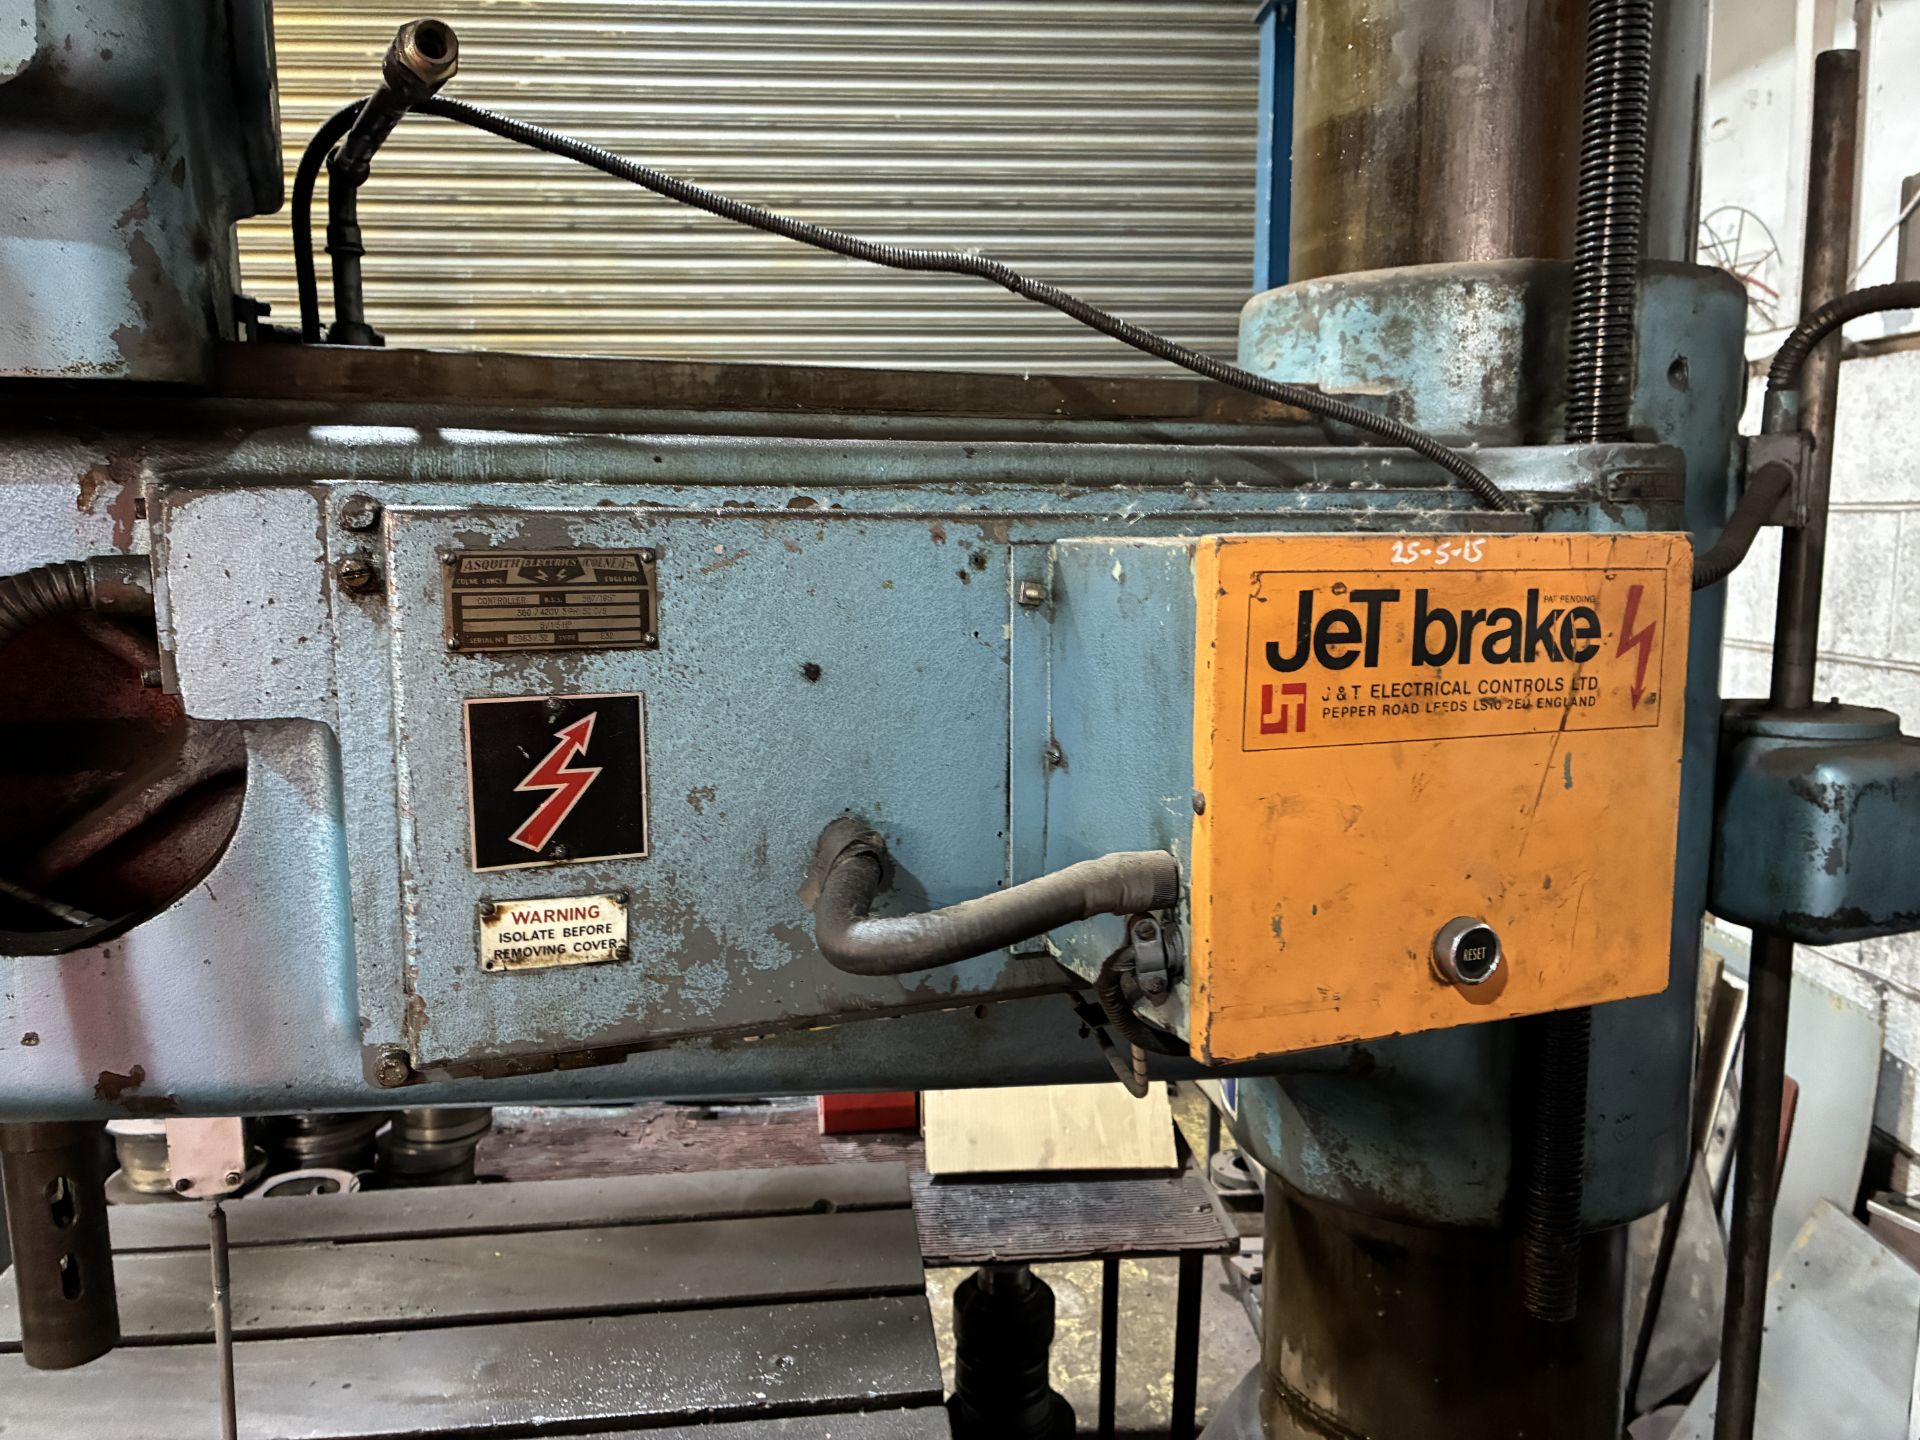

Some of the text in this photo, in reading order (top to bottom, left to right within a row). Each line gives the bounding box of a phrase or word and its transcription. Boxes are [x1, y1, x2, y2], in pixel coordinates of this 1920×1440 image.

[1390, 537, 1487, 565] 25-5-15
[464, 558, 520, 571] ASQUITH
[522, 558, 577, 568] ELECTRICS
[477, 596, 526, 605] CONTROLLER
[1560, 594, 1596, 603] PENDING
[1411, 587, 1602, 667] brake
[1336, 686, 1347, 701] &
[1352, 684, 1362, 700] T
[1370, 680, 1472, 699] ELECTRICAL
[1478, 677, 1564, 694] CONTROLS
[1572, 676, 1598, 691] LTD
[1322, 706, 1376, 719] PEPPER
[1382, 702, 1420, 716] ROAD
[1536, 696, 1596, 709] ENGLAND
[510, 905, 600, 926] WARNING
[498, 923, 613, 944] ISOLATE BEFORE
[494, 938, 618, 960] REMOVING COVER
[1462, 947, 1487, 961] RESET
